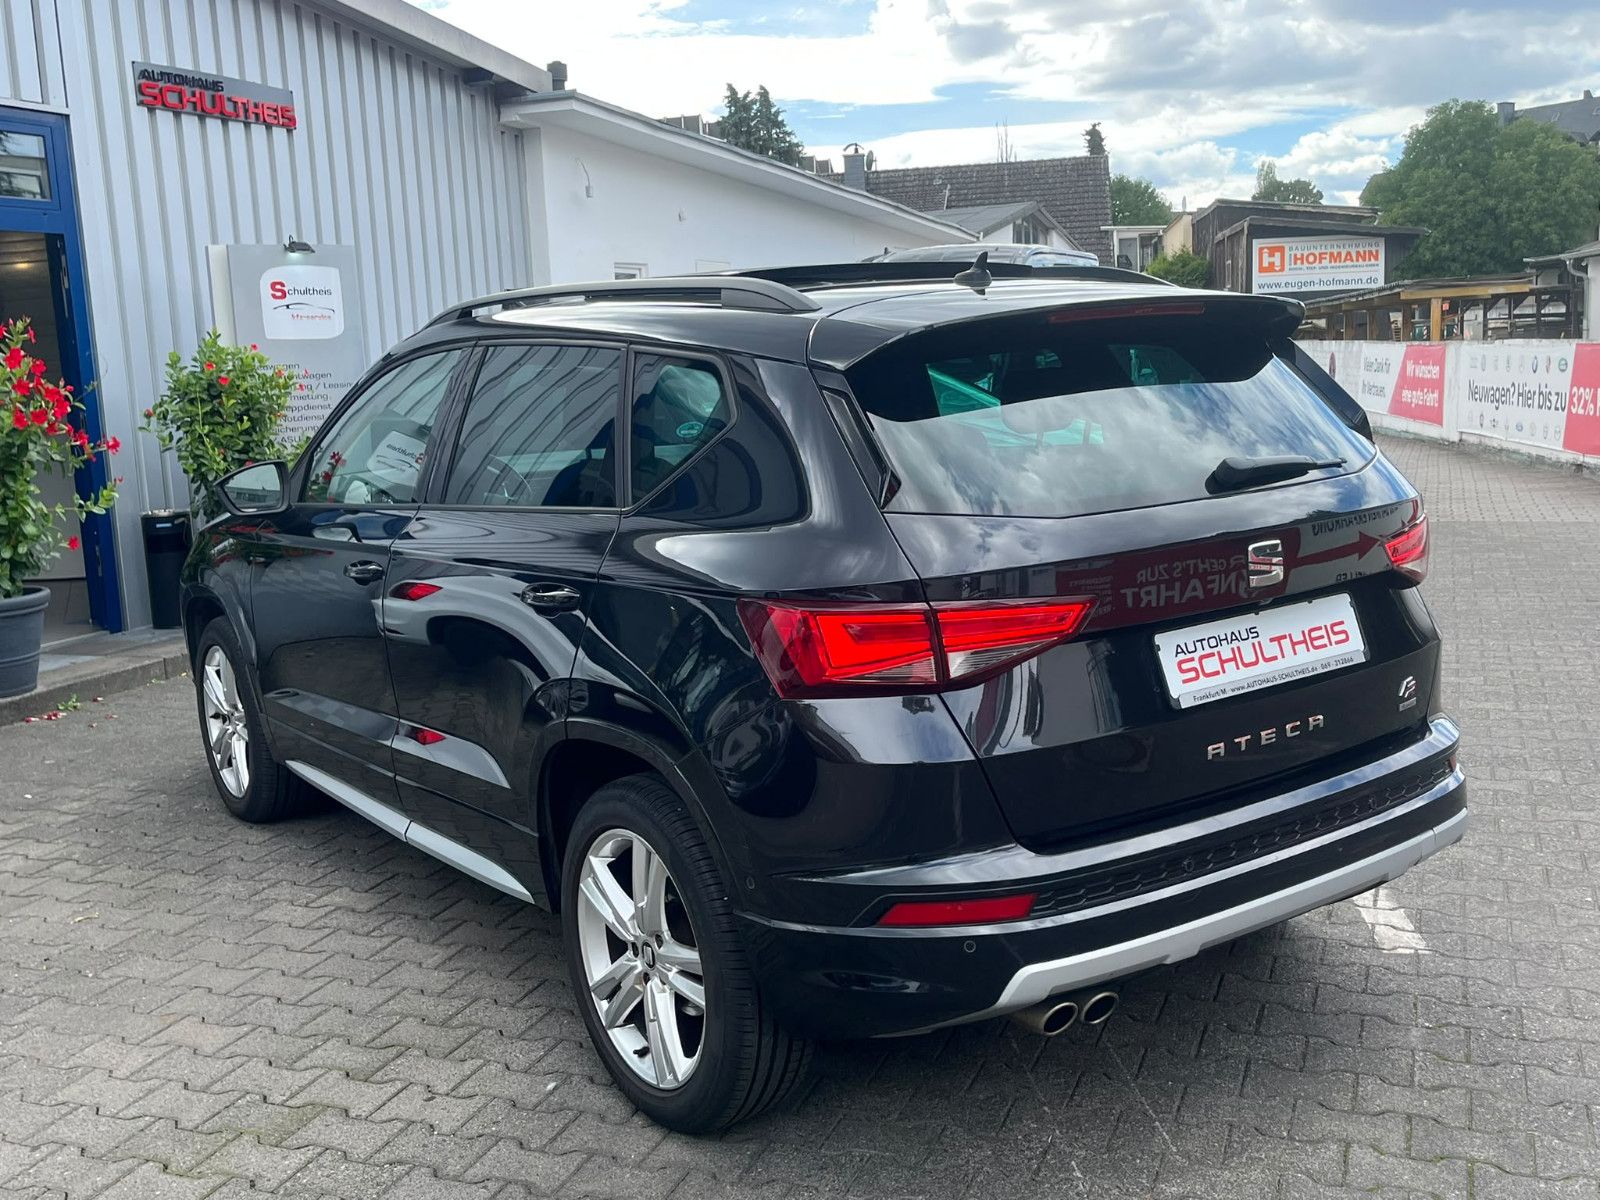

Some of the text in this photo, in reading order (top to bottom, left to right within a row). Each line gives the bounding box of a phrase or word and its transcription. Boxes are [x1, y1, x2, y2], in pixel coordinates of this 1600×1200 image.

[138, 69, 224, 92] AUTOHAUS
[139, 81, 297, 128] SCHULTHEIS
[1288, 241, 1380, 251] BAUUNTERNEHMUNG
[1293, 249, 1380, 266] HOFMANN
[270, 280, 333, 300] Schultheis
[1257, 276, 1379, 290] www.eugen-hofmann.de
[1415, 360, 1440, 379] wünschen
[1411, 388, 1423, 407] gute
[1468, 379, 1516, 411] Neuwagen?
[1517, 382, 1537, 408] Hier
[1538, 382, 1552, 411] bis
[1554, 391, 1567, 412] zu
[1571, 385, 1595, 416] 32%
[1174, 626, 1260, 657] AUTOHAUS
[1176, 620, 1350, 684] SCHULTHEIS
[1230, 667, 1319, 692] www.AUTOHAUS-SCHULTHEIS.de
[1207, 714, 1324, 760] ATECA
